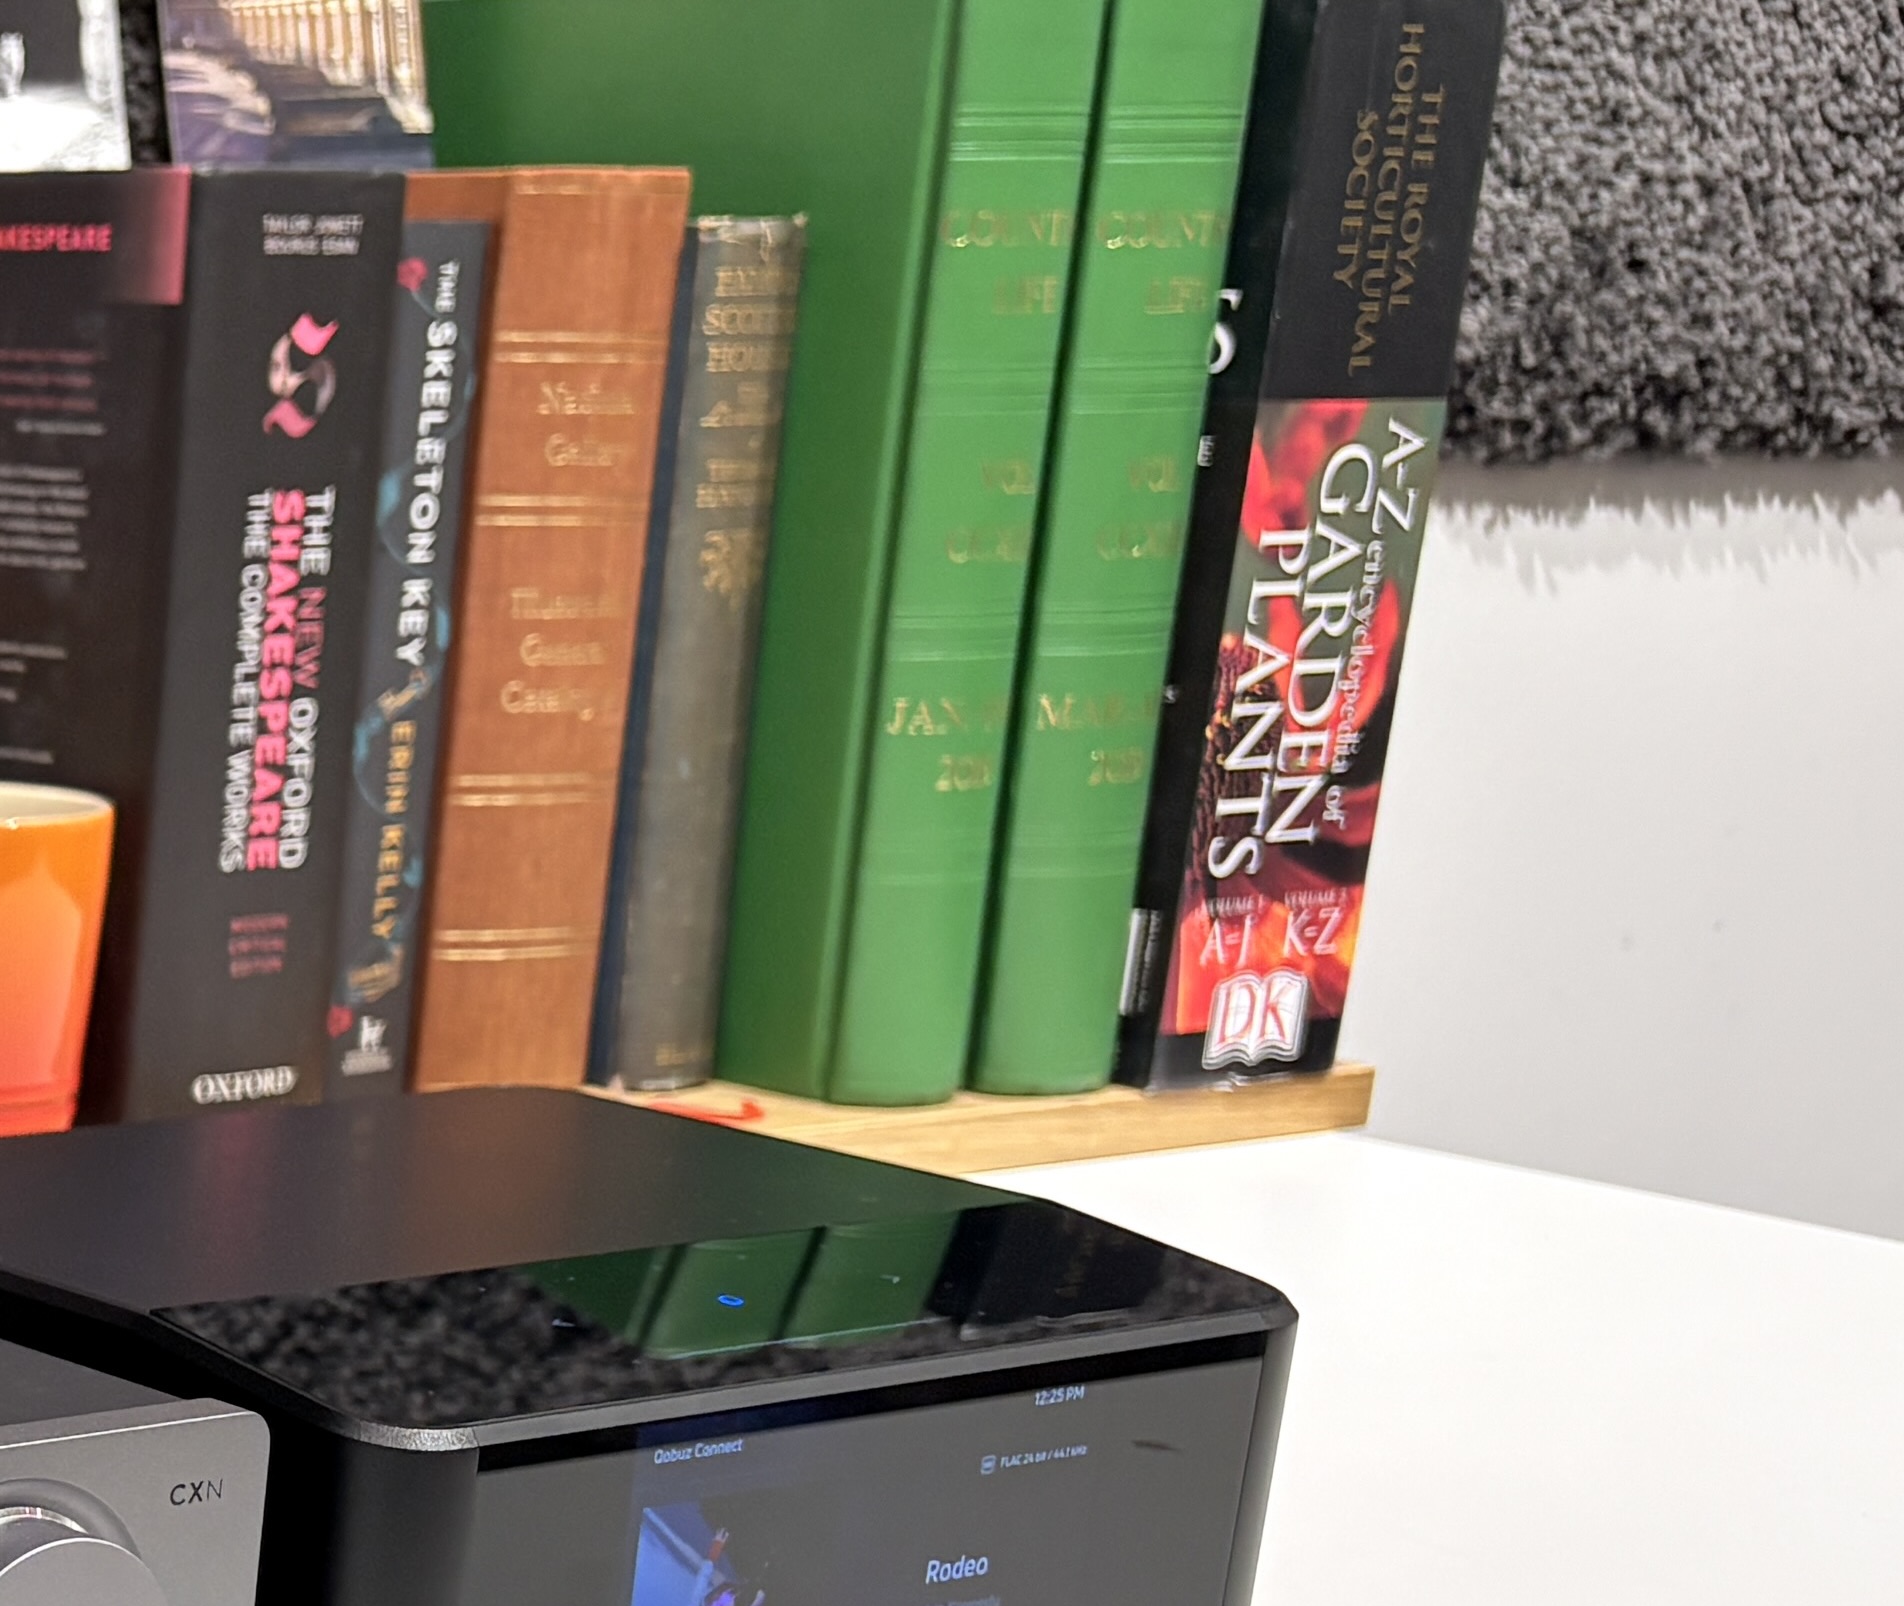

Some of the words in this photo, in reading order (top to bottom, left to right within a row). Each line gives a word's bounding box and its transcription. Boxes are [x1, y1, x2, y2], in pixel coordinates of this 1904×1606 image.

[1410, 82, 1446, 171] THE
[1332, 108, 1379, 290] SOCIETY
[1347, 22, 1425, 378] HORTICULTURAL
[1388, 182, 1428, 308] ROYAL
[406, 320, 459, 566] SKELETON
[243, 488, 272, 560] THE
[299, 485, 337, 577] THE
[227, 563, 268, 747] COMPLETE
[292, 586, 329, 690] NEW
[394, 577, 434, 668] KEY
[1262, 442, 1379, 847] GARDEN
[246, 489, 306, 871] SHAKESPEARE
[1206, 527, 1314, 879] PLANTS
[218, 748, 257, 874] WORKS
[279, 696, 319, 870] OXFORD
[385, 719, 417, 814] ERIN
[371, 823, 406, 941] KELLY
[1217, 977, 1297, 1046] DK
[192, 1065, 298, 1105] OXFORD
[1034, 1388, 1065, 1407] 12:25
[1065, 1384, 1086, 1403] PM
[169, 1478, 224, 1507] CXN
[653, 1444, 692, 1466] Qobuz
[694, 1436, 744, 1459] Connect
[924, 1554, 989, 1586] Rodeo
